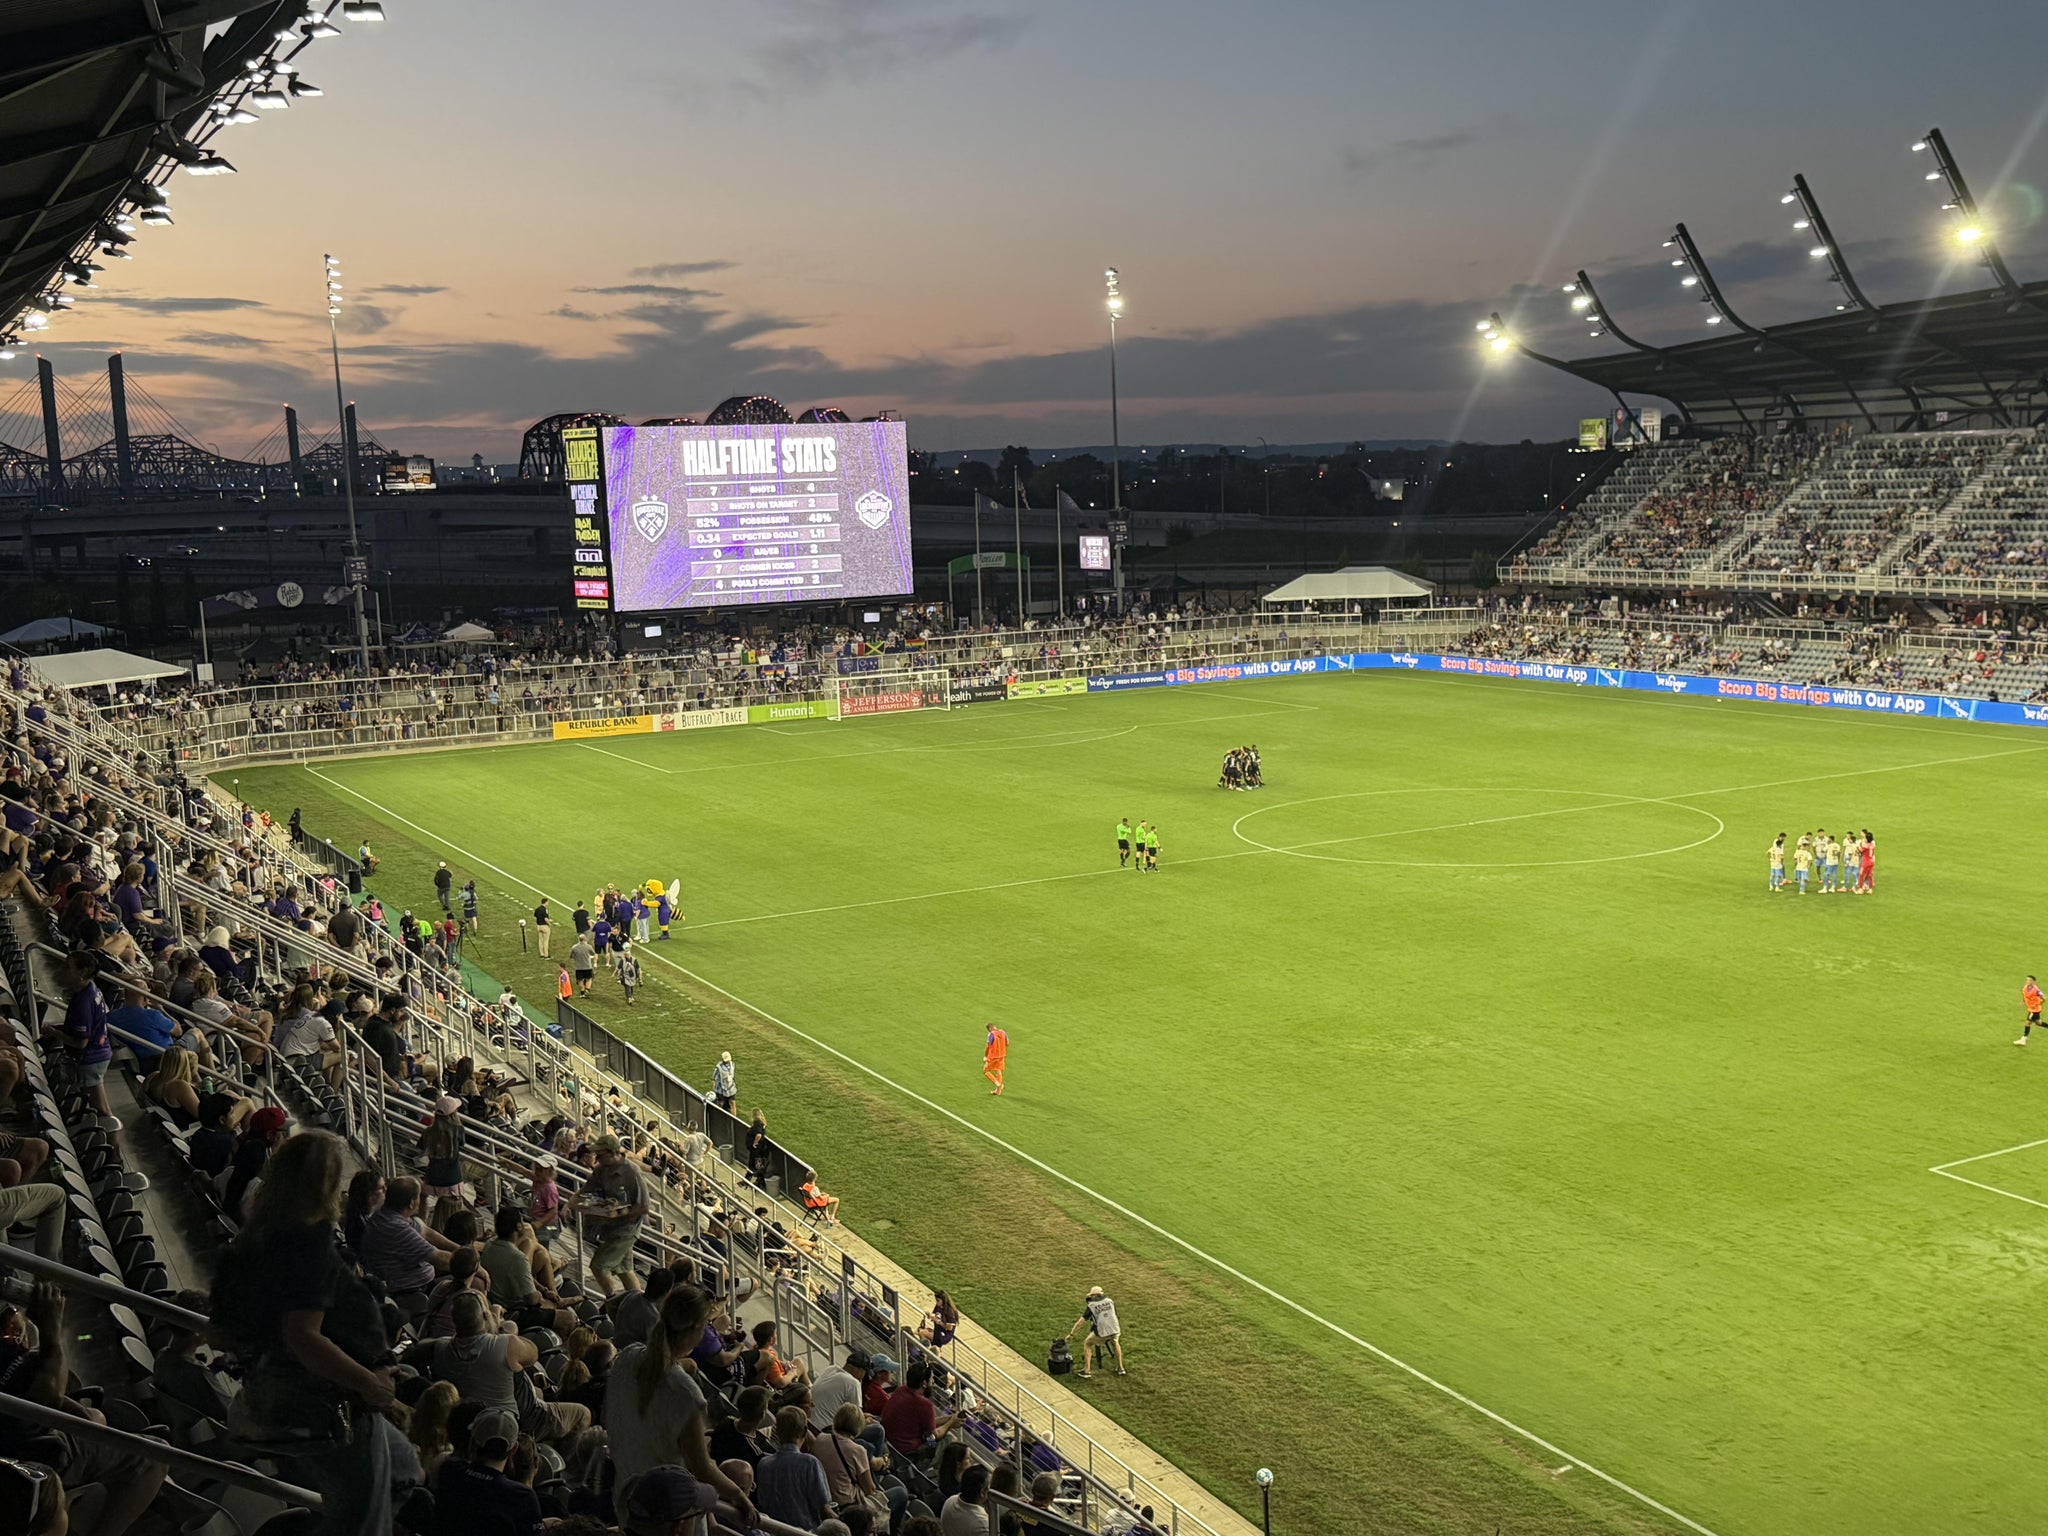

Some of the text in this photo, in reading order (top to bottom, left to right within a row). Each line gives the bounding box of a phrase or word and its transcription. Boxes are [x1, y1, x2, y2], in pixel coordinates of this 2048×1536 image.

[565, 440, 598, 462] LOUDER
[683, 437, 837, 476] HALFTIME STATS
[586, 461, 599, 480] LIFE
[710, 483, 815, 496] 7 SHOTS 4
[711, 498, 816, 512] 3 SHOTS ON TARGET 2
[696, 518, 720, 528] 52%
[740, 516, 789, 526] POSSESSION
[696, 534, 721, 544] 0.34
[732, 532, 772, 541] EXPECTED
[773, 530, 799, 539] GOALS
[713, 544, 818, 559] 0 SAVES 2
[715, 560, 819, 574] 7 CORNER KICKS 2
[716, 575, 820, 590] 4 FOULS COMMITTED 2
[1177, 669, 1195, 683] Big
[1197, 666, 1242, 681] Savings
[1244, 663, 1268, 676] with
[1271, 661, 1292, 673] Our
[1293, 658, 1316, 673] App
[1440, 657, 1466, 670] Score
[1468, 658, 1483, 674] Big
[1485, 659, 1520, 676] Savings
[1522, 663, 1543, 677] with
[1545, 665, 1563, 679] Our
[1565, 667, 1588, 683] App
[853, 693, 910, 707] JEFFERSON
[943, 690, 972, 702] Health
[1718, 680, 1752, 696] Score
[1756, 683, 1777, 700] Big
[1780, 685, 1830, 704] Savings
[1833, 689, 1860, 705] with
[1866, 692, 1891, 708] Our
[1894, 696, 1925, 713] App
[853, 704, 875, 713] ANIMAL
[569, 717, 638, 729] REPUBLIC BANK
[682, 711, 742, 727] BUFFALO TRACE
